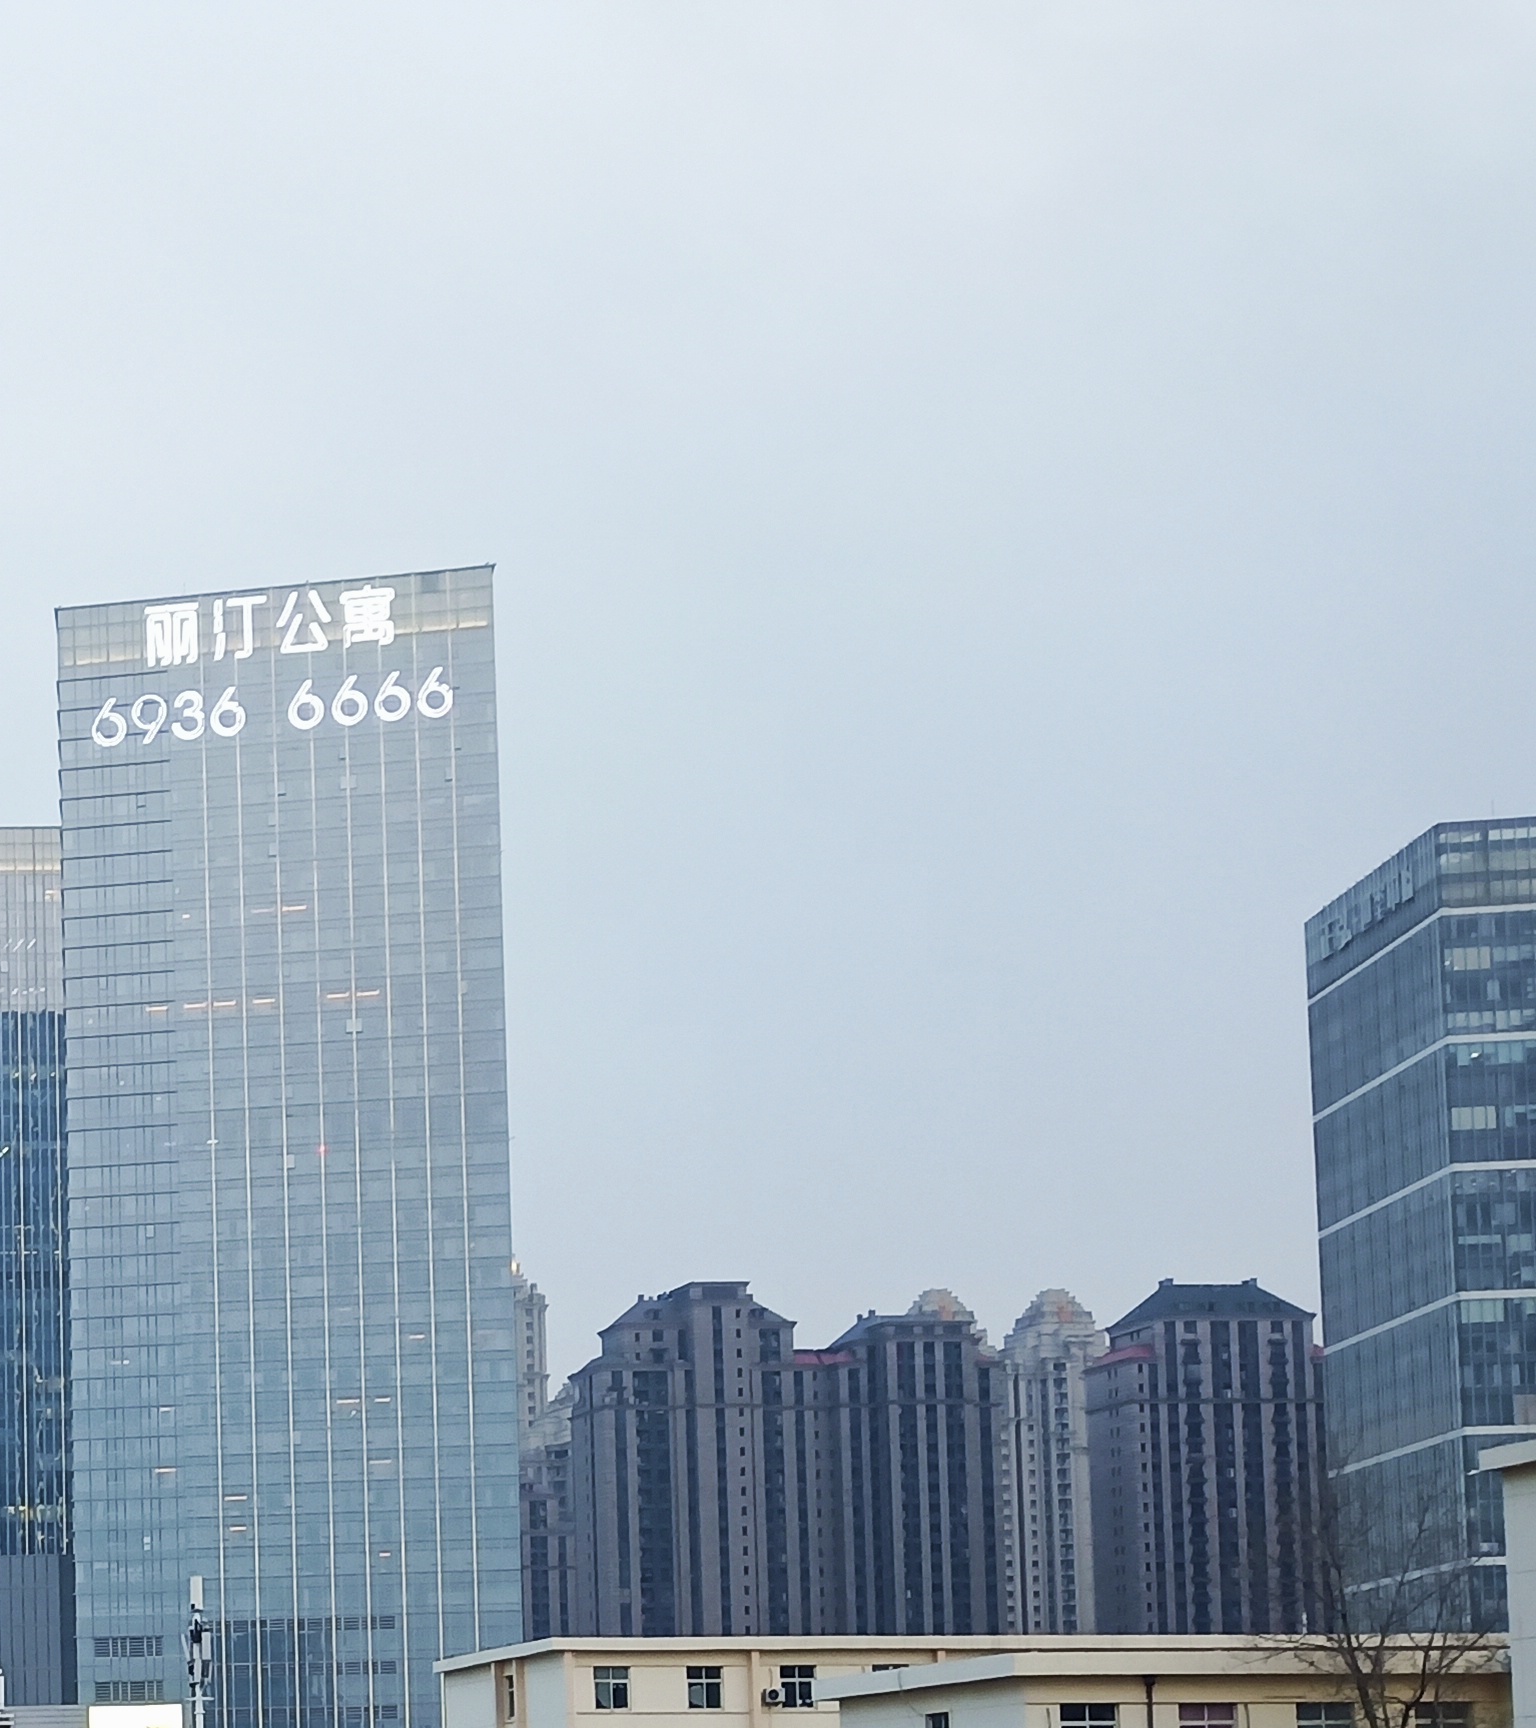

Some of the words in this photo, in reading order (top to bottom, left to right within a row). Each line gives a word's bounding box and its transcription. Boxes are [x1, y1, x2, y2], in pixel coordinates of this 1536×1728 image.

[143, 584, 396, 667] 丽汀公寓
[91, 686, 247, 747] 6936
[287, 666, 454, 730] 6666
